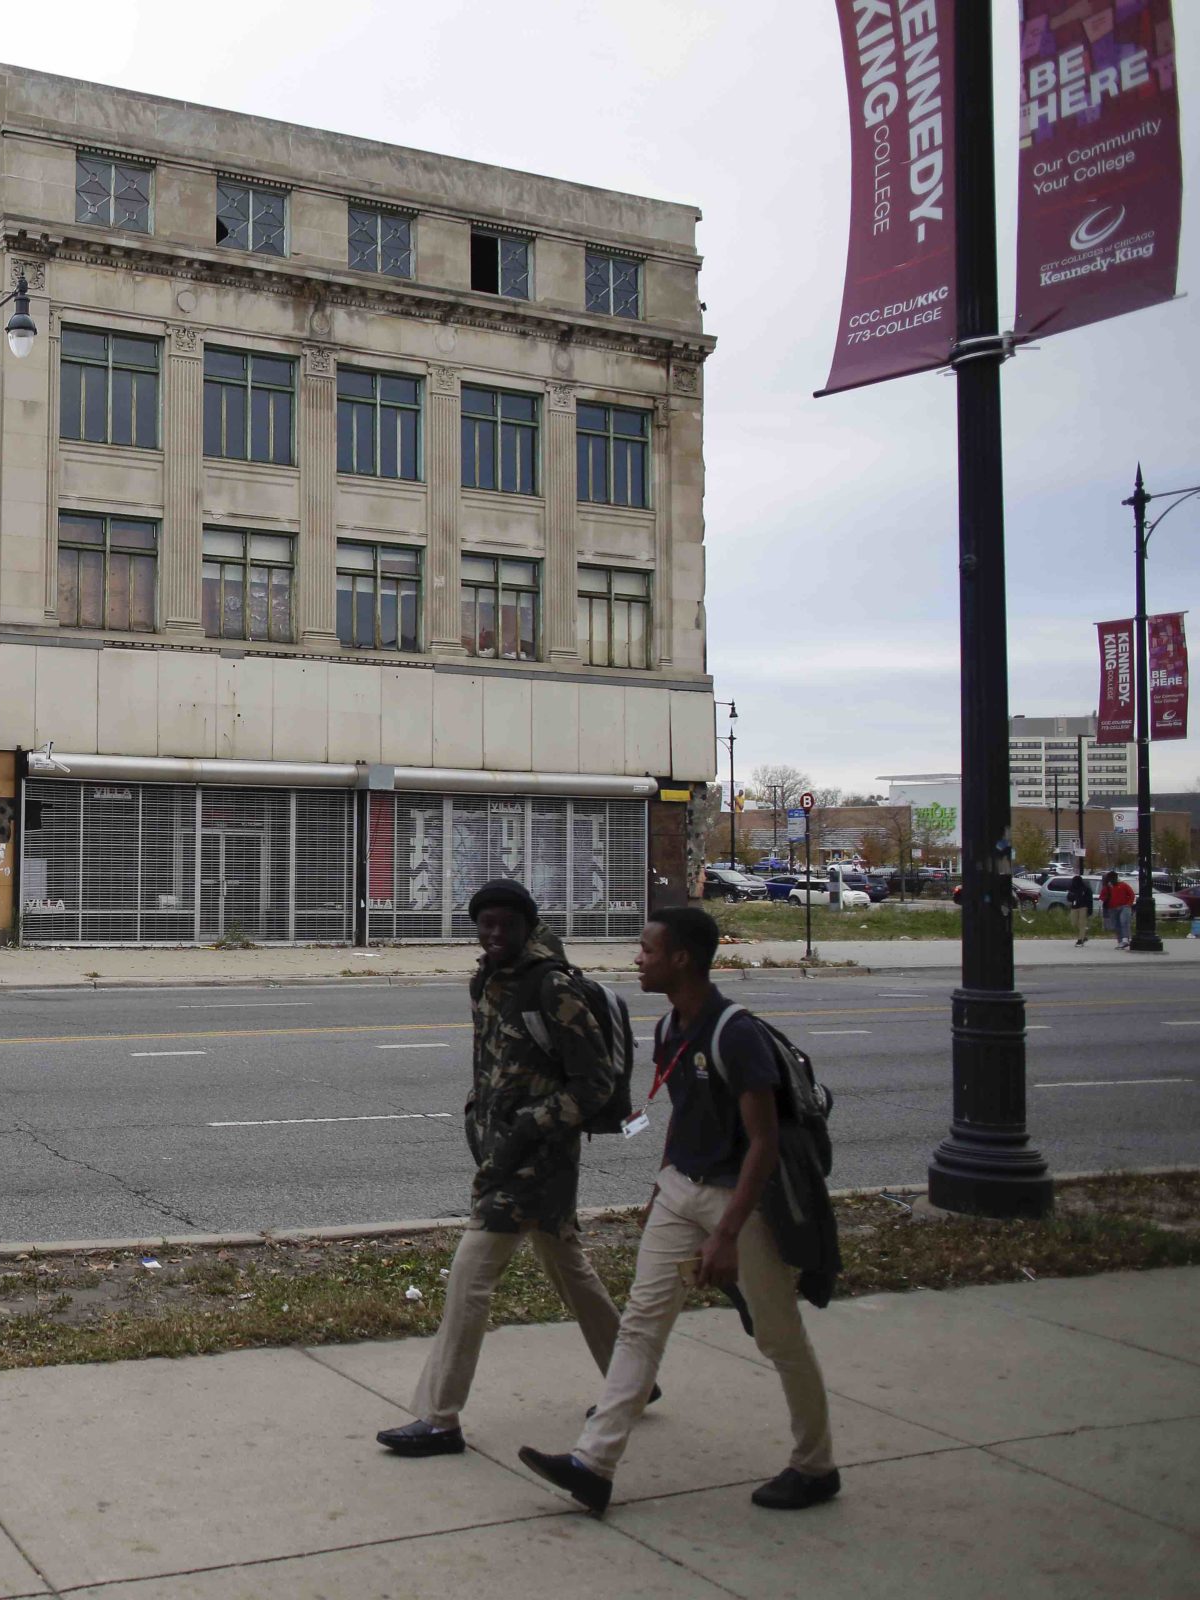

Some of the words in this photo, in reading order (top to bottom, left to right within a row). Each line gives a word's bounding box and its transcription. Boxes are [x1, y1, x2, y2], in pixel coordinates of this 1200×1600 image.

[1029, 45, 1085, 98] BE
[1029, 50, 1150, 131] HERE
[898, 0, 943, 243] ENNEDY-
[1033, 158, 1063, 178] Our
[1067, 119, 1161, 165] Community
[873, 125, 890, 236] COLLEGE
[1033, 175, 1069, 196] Your
[1073, 151, 1135, 182] College
[1040, 260, 1060, 273] CITY
[1060, 247, 1104, 266] COLLEGES
[1114, 230, 1155, 249] CHICAGO
[1040, 243, 1155, 287] Kennedy-King
[847, 307, 942, 345] 773-COLLEGE
[849, 286, 949, 328] CCC.EDU/KKC
[1104, 634, 1116, 670] KING
[1118, 632, 1130, 706] KENNEDY-
[1152, 670, 1167, 679] BE
[1152, 676, 1182, 687] HERE
[94, 788, 132, 797] VILLA
[491, 802, 522, 811] VILLA
[803, 796, 812, 807] B
[914, 807, 957, 819] WHOLE
[608, 900, 638, 910] VILLA
